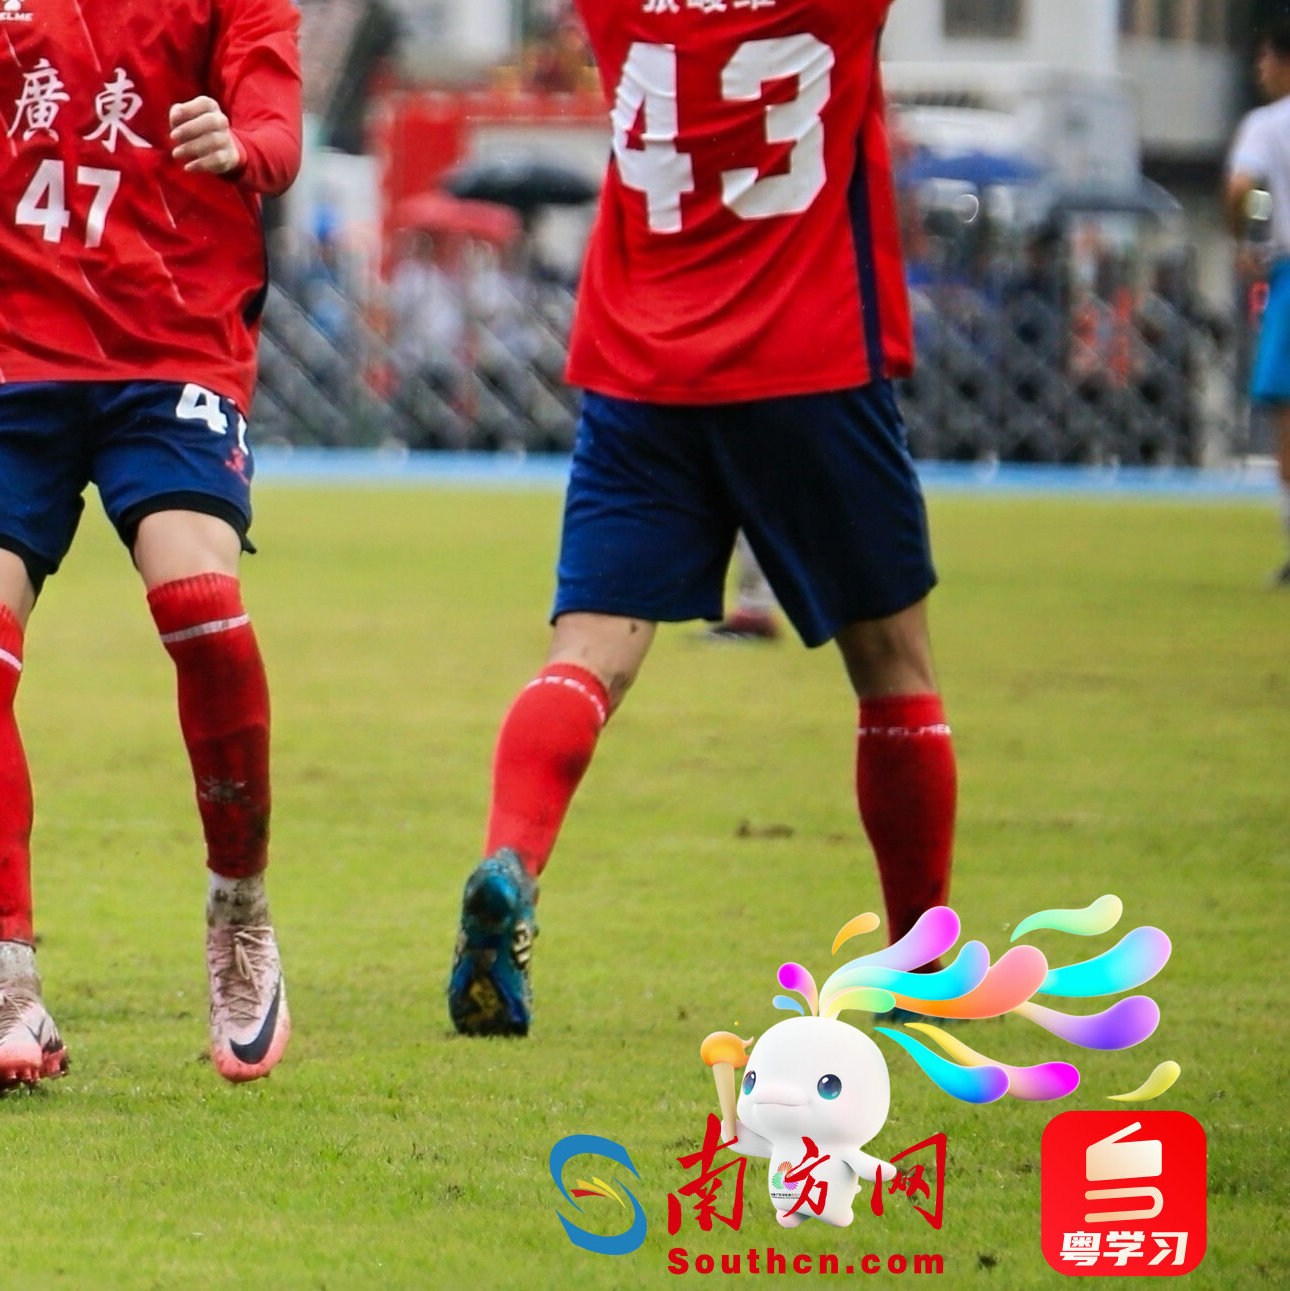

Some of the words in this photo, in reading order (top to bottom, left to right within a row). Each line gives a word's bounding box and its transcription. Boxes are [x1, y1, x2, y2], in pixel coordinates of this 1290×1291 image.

[7, 57, 153, 153] 廣東
[610, 31, 836, 234] 43
[15, 159, 121, 249] 47
